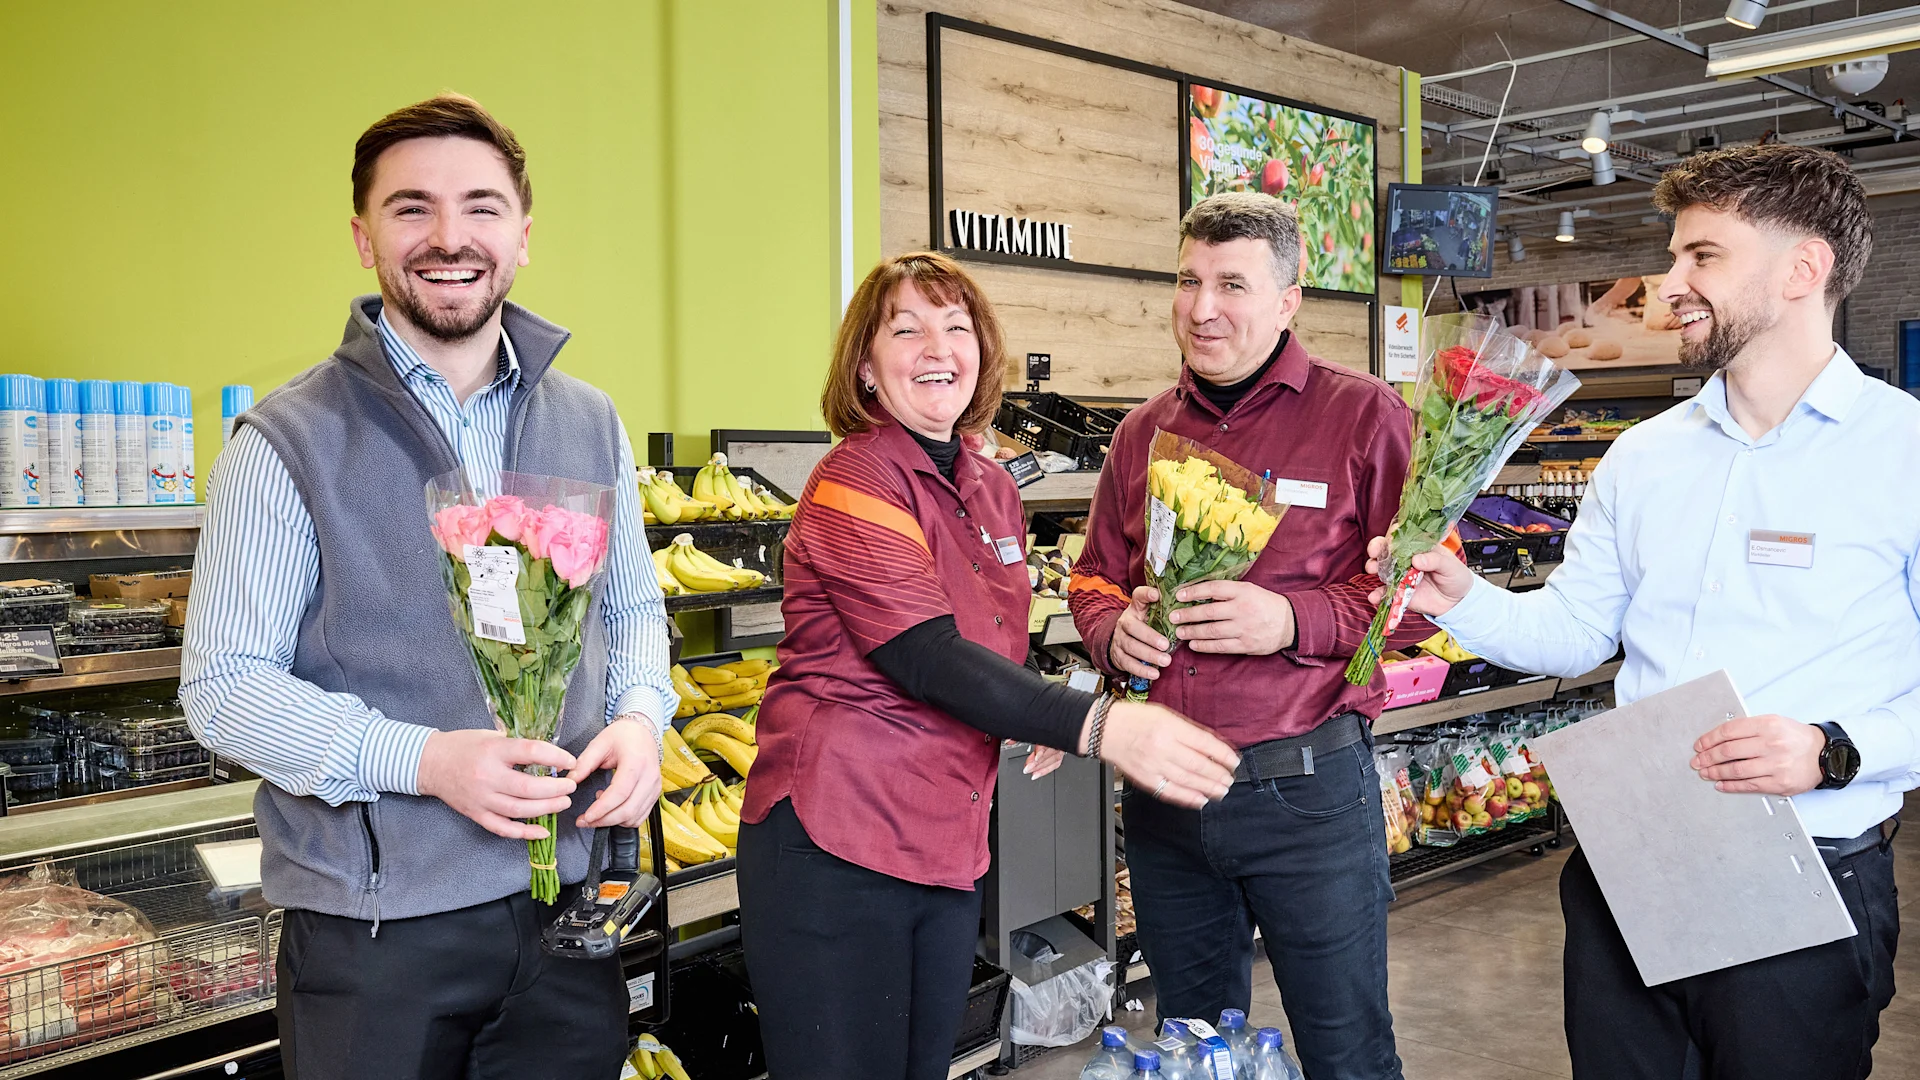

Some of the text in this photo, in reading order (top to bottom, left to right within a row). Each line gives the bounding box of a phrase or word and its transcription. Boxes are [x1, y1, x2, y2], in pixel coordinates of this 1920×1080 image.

[1218, 143, 1262, 161] gesunde
[1199, 154, 1250, 177] Vitamine.
[953, 208, 1073, 260] VITAMINE
[1779, 535, 1808, 544] MIGROS
[0, 632, 19, 642] .25
